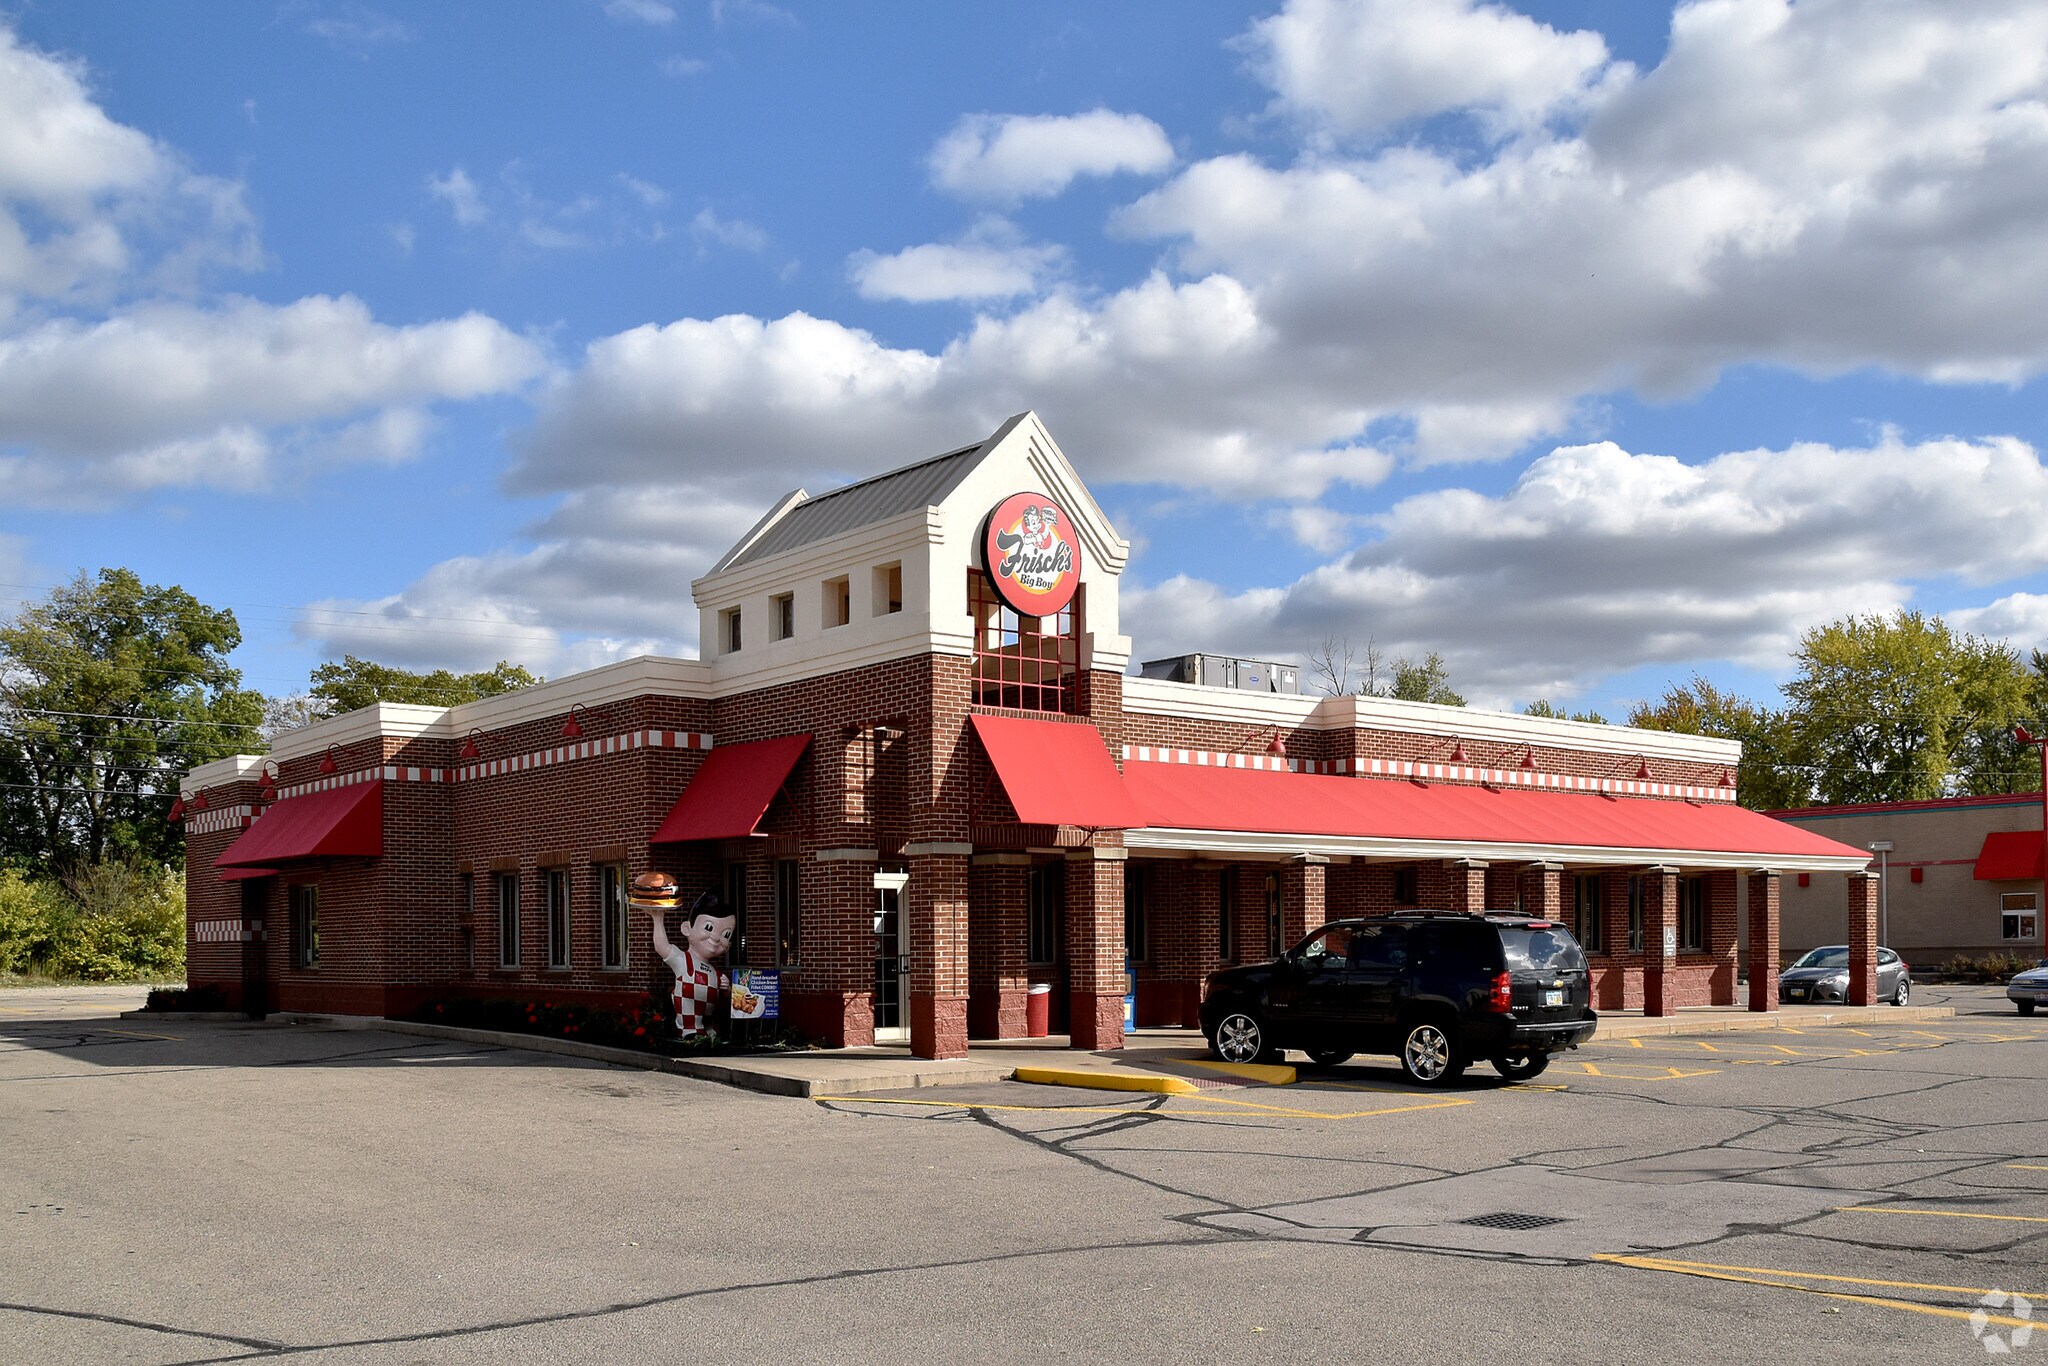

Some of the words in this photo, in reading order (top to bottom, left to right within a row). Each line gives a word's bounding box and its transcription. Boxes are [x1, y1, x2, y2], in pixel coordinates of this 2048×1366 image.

[996, 529, 1072, 577] Frisch's
[1020, 574, 1034, 587] Big
[1035, 577, 1053, 590] Boy
